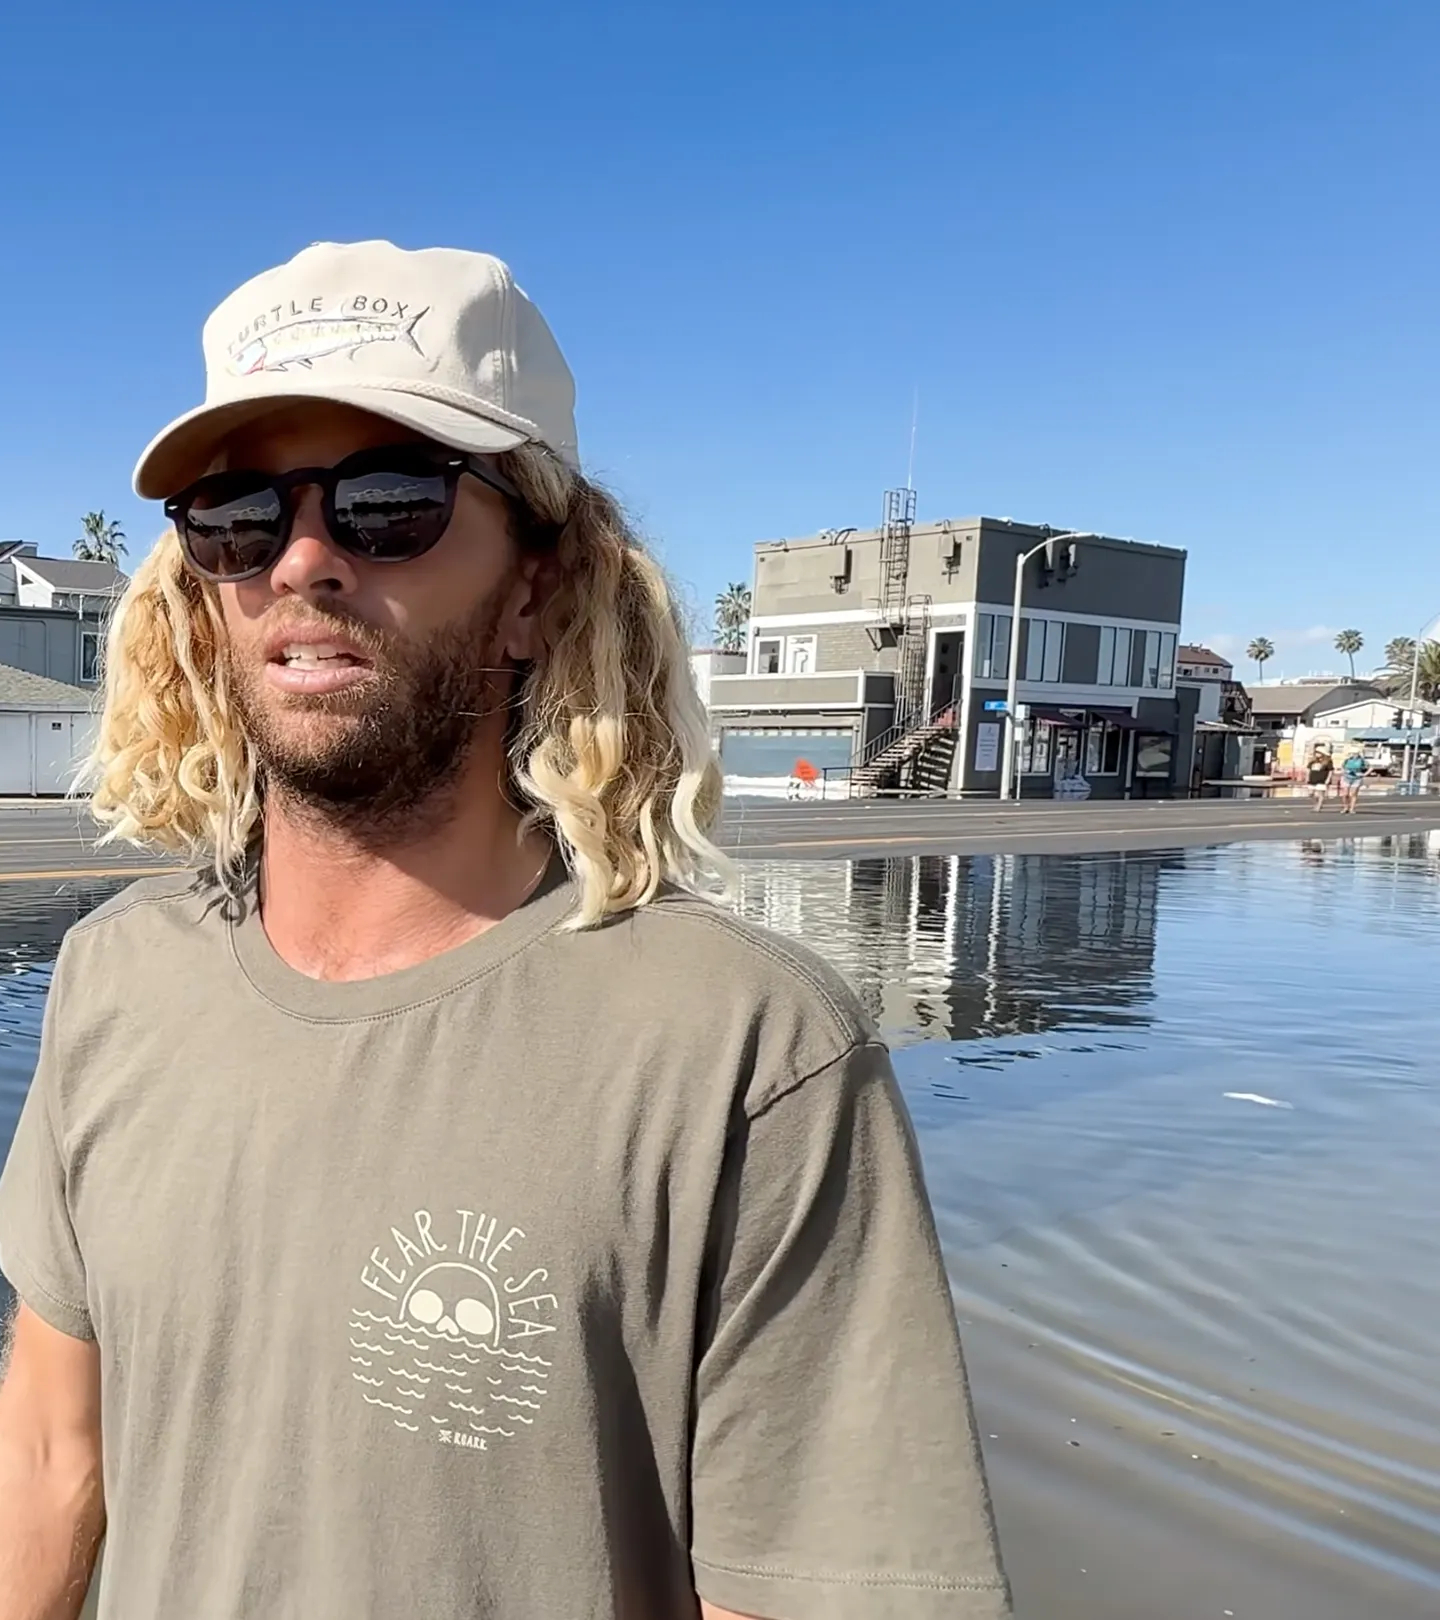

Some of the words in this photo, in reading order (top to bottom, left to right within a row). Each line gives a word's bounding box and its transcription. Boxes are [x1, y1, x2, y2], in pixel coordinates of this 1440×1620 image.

[227, 296, 323, 355] TURTLE
[353, 295, 408, 319] BOX
[361, 1209, 447, 1300] FEAR
[456, 1209, 526, 1273] THE
[503, 1268, 558, 1339] SEA
[453, 1431, 488, 1450] ROARK
